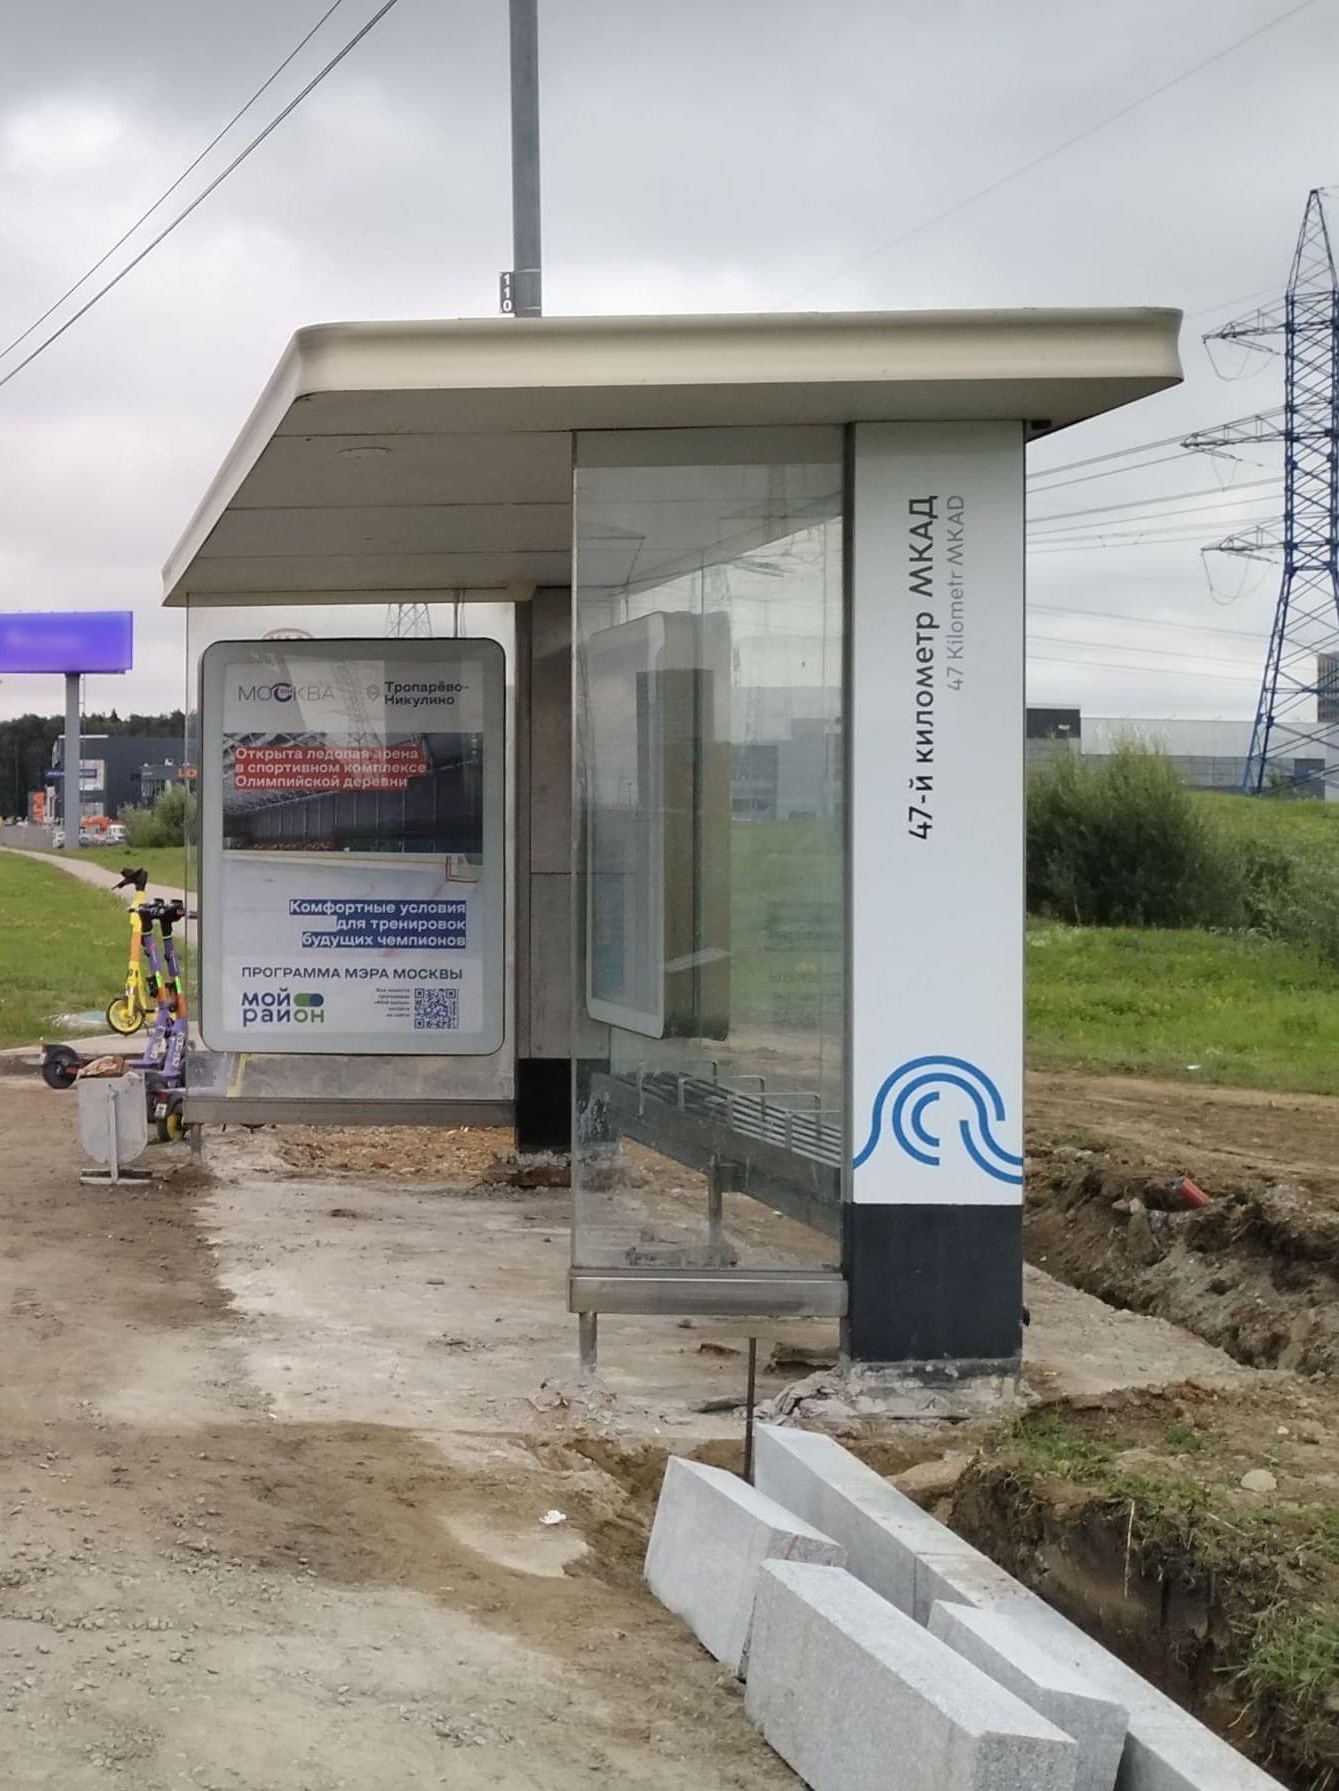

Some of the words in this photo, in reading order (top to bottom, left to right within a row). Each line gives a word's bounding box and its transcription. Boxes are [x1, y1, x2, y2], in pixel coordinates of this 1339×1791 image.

[946, 495, 965, 566] MKAD
[908, 495, 938, 597] МКАД
[946, 571, 964, 660] Kilometr
[915, 611, 940, 763] километр
[946, 665, 964, 691] 47
[238, 682, 334, 702] МОСКВА
[384, 694, 455, 708] Никулино
[235, 747, 303, 761] Открыта
[306, 749, 370, 761] ледовая
[373, 749, 419, 761] арена
[235, 763, 244, 774] в
[247, 763, 341, 776] спортивном
[344, 763, 427, 774] комплексе
[235, 775, 340, 788] Олимпийской
[343, 777, 408, 789] деревни
[908, 775, 934, 840] 47-й
[289, 900, 396, 916] Комфортные
[400, 903, 466, 916] условия
[337, 919, 366, 930] для
[370, 919, 466, 933] тренировок
[302, 932, 374, 948] будущих
[377, 935, 466, 947] чемпионов
[242, 966, 342, 979] ПРОГРАММА
[345, 967, 389, 980] МЭРА
[393, 968, 463, 981] МОСКВЫ
[241, 986, 291, 1008] мой
